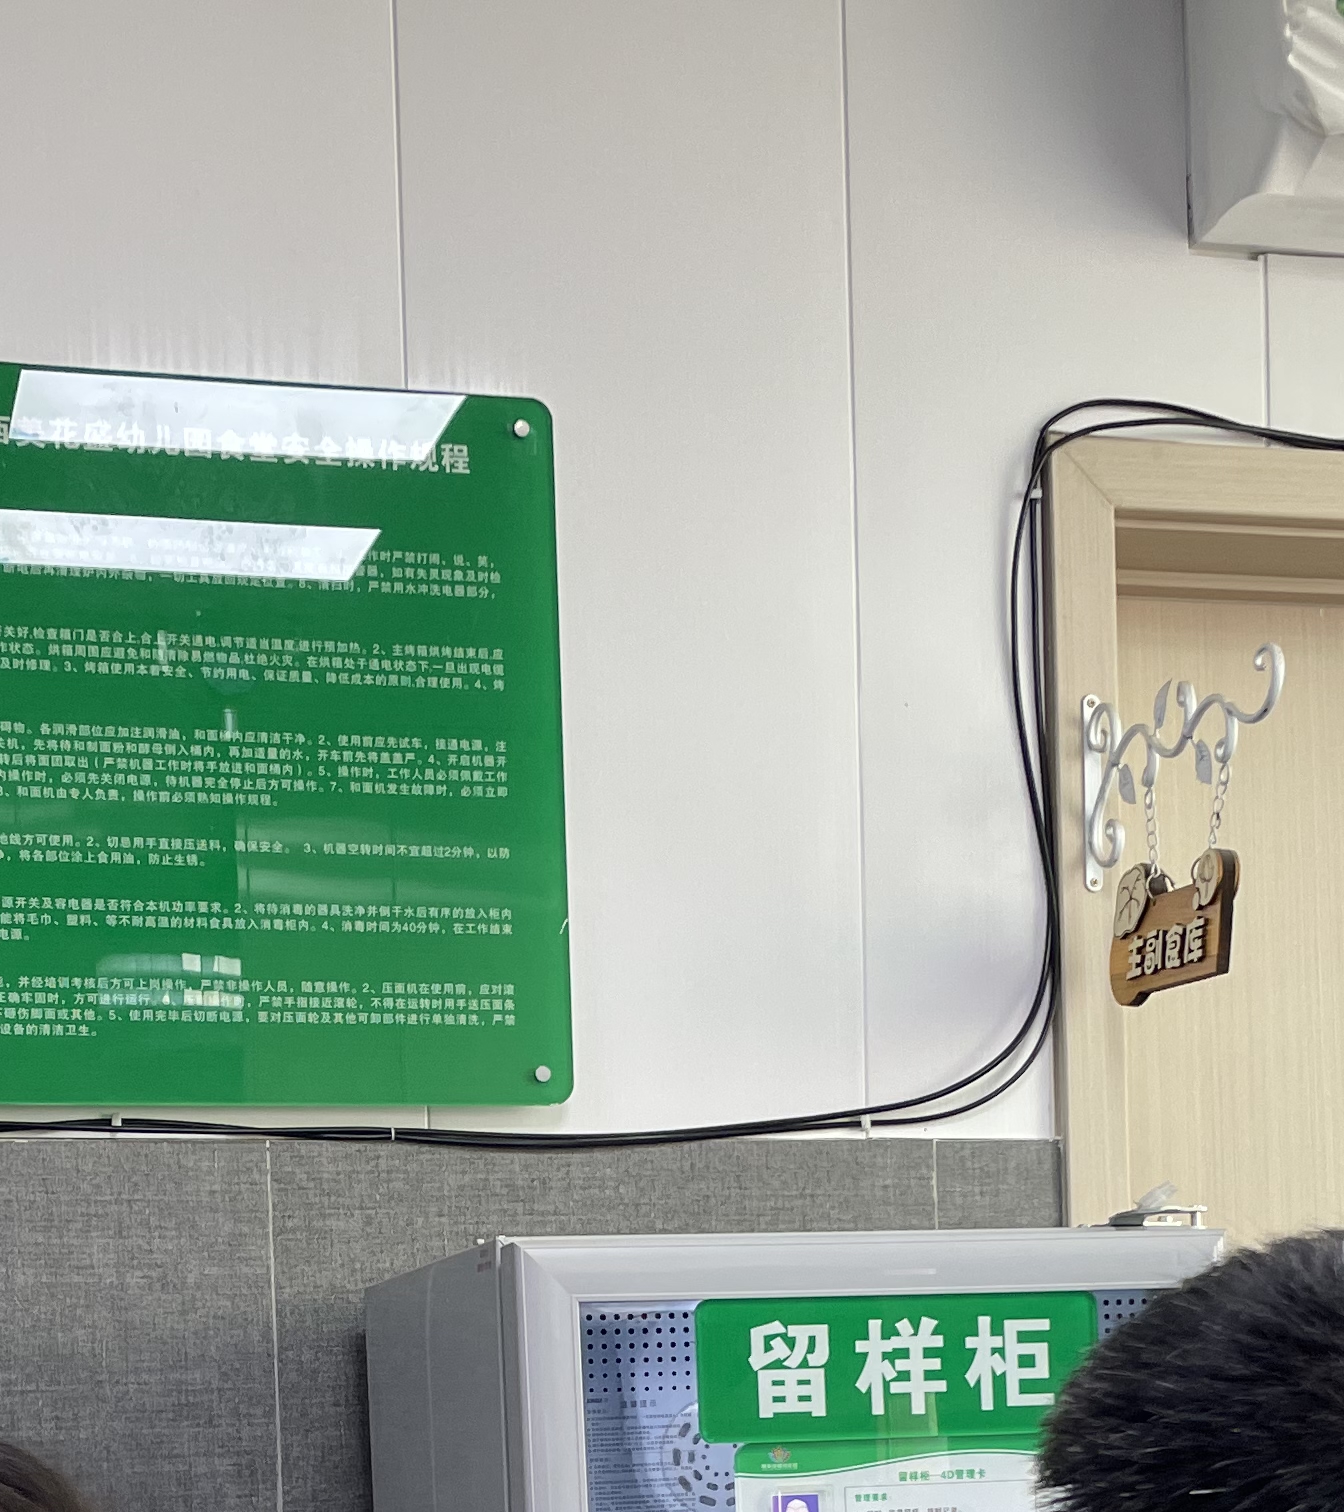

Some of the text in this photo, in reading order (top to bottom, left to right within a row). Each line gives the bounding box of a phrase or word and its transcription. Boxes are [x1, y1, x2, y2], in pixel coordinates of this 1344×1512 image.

[1126, 917, 1205, 980] 主副食库
[748, 1315, 1055, 1418] 留样柜
